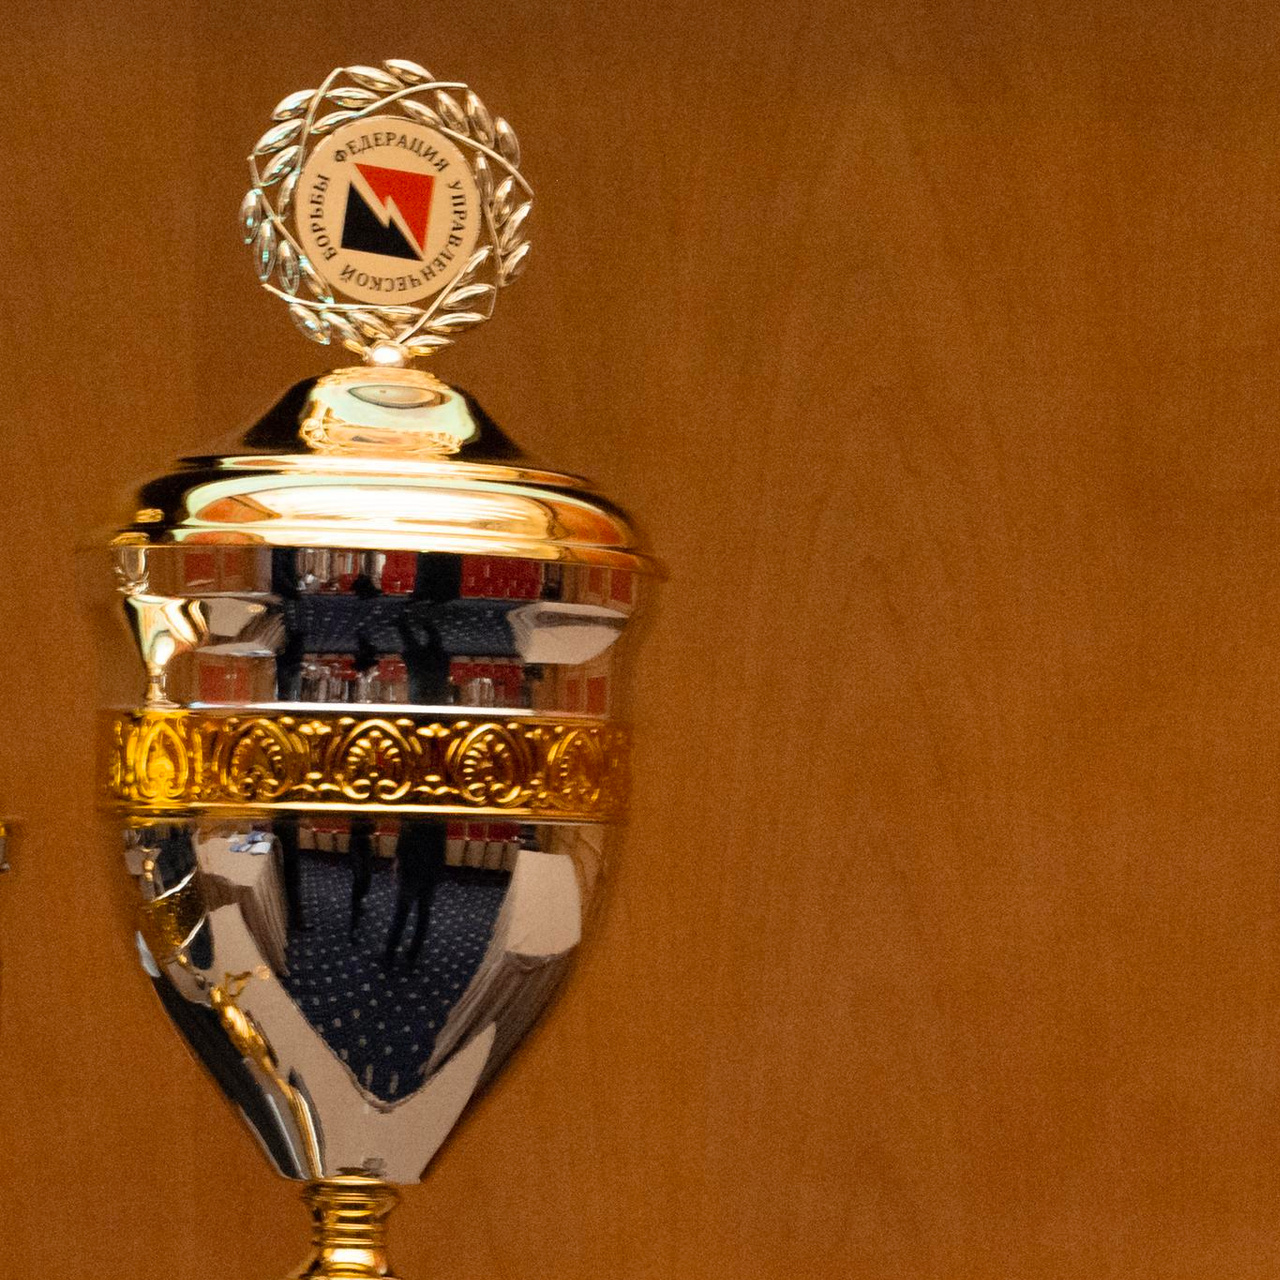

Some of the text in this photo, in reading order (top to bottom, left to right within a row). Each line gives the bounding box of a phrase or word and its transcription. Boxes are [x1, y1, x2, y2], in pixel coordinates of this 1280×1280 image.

[310, 132, 466, 292] ФЕДЕРАЦИЯ УПРАВЛЕНЧЕСКОЙ БОРЬБЫ
